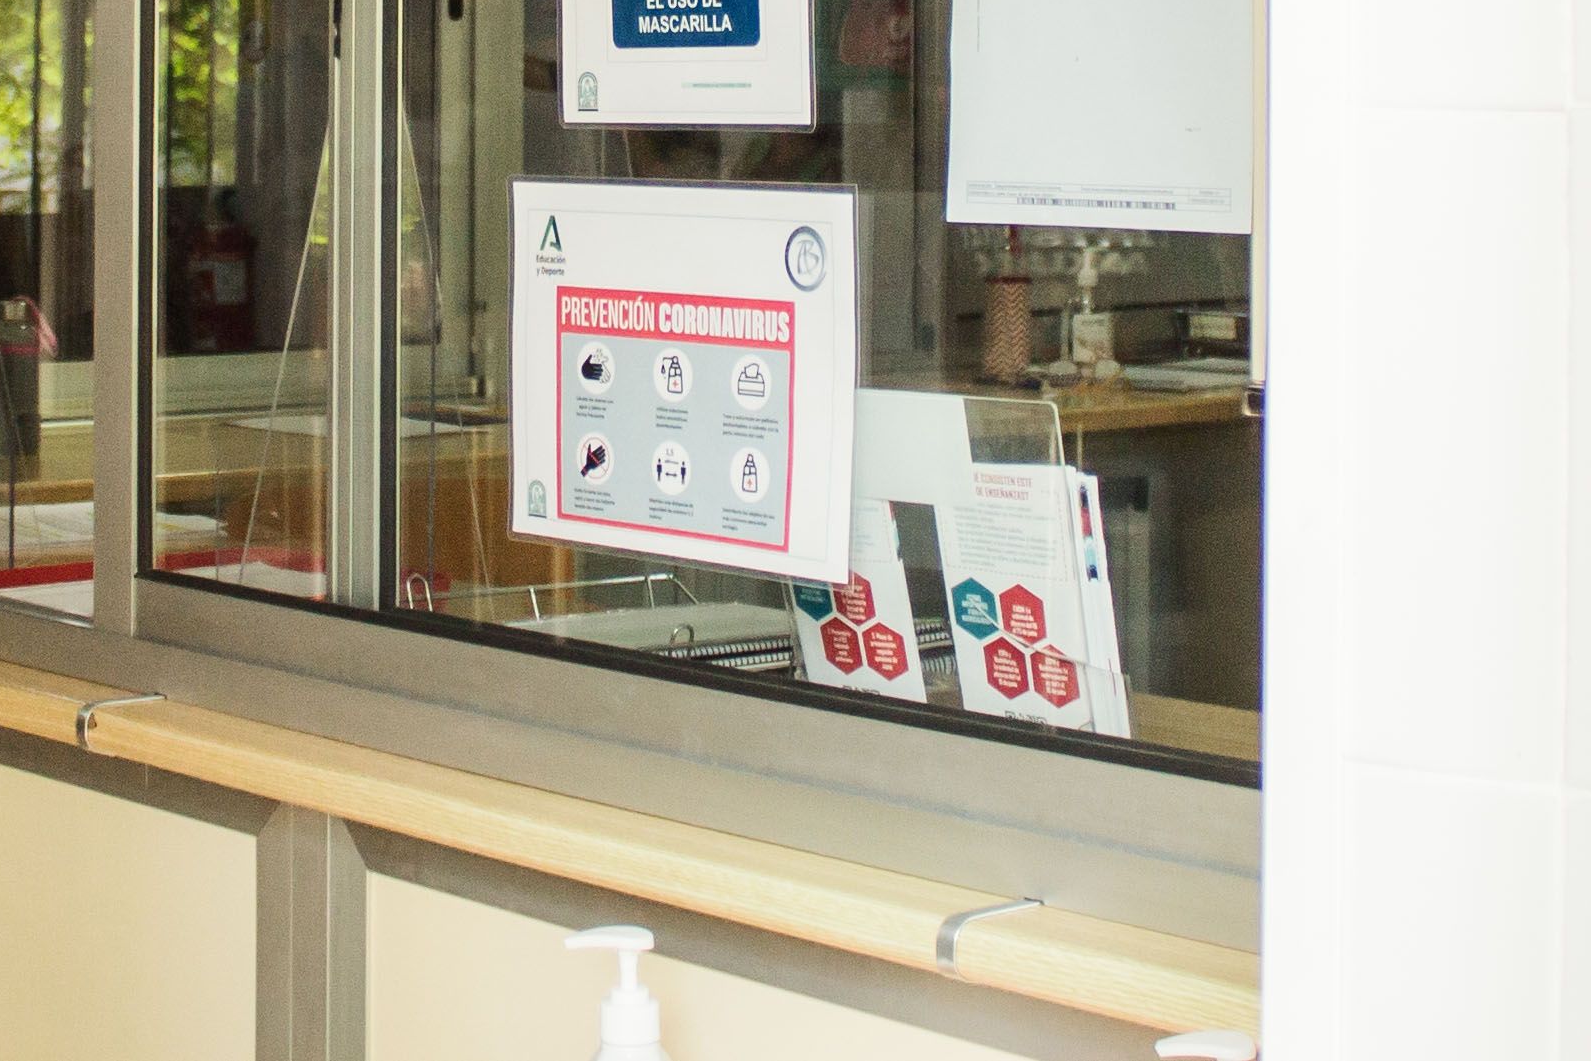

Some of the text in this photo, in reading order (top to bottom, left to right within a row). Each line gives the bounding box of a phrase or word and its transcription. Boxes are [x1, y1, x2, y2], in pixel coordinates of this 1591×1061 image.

[638, 13, 733, 34] MASCARILLA
[536, 254, 566, 264] Educación
[541, 266, 565, 277] Deporte
[561, 295, 790, 343] PREVENCIÓN CORONAVIRUS
